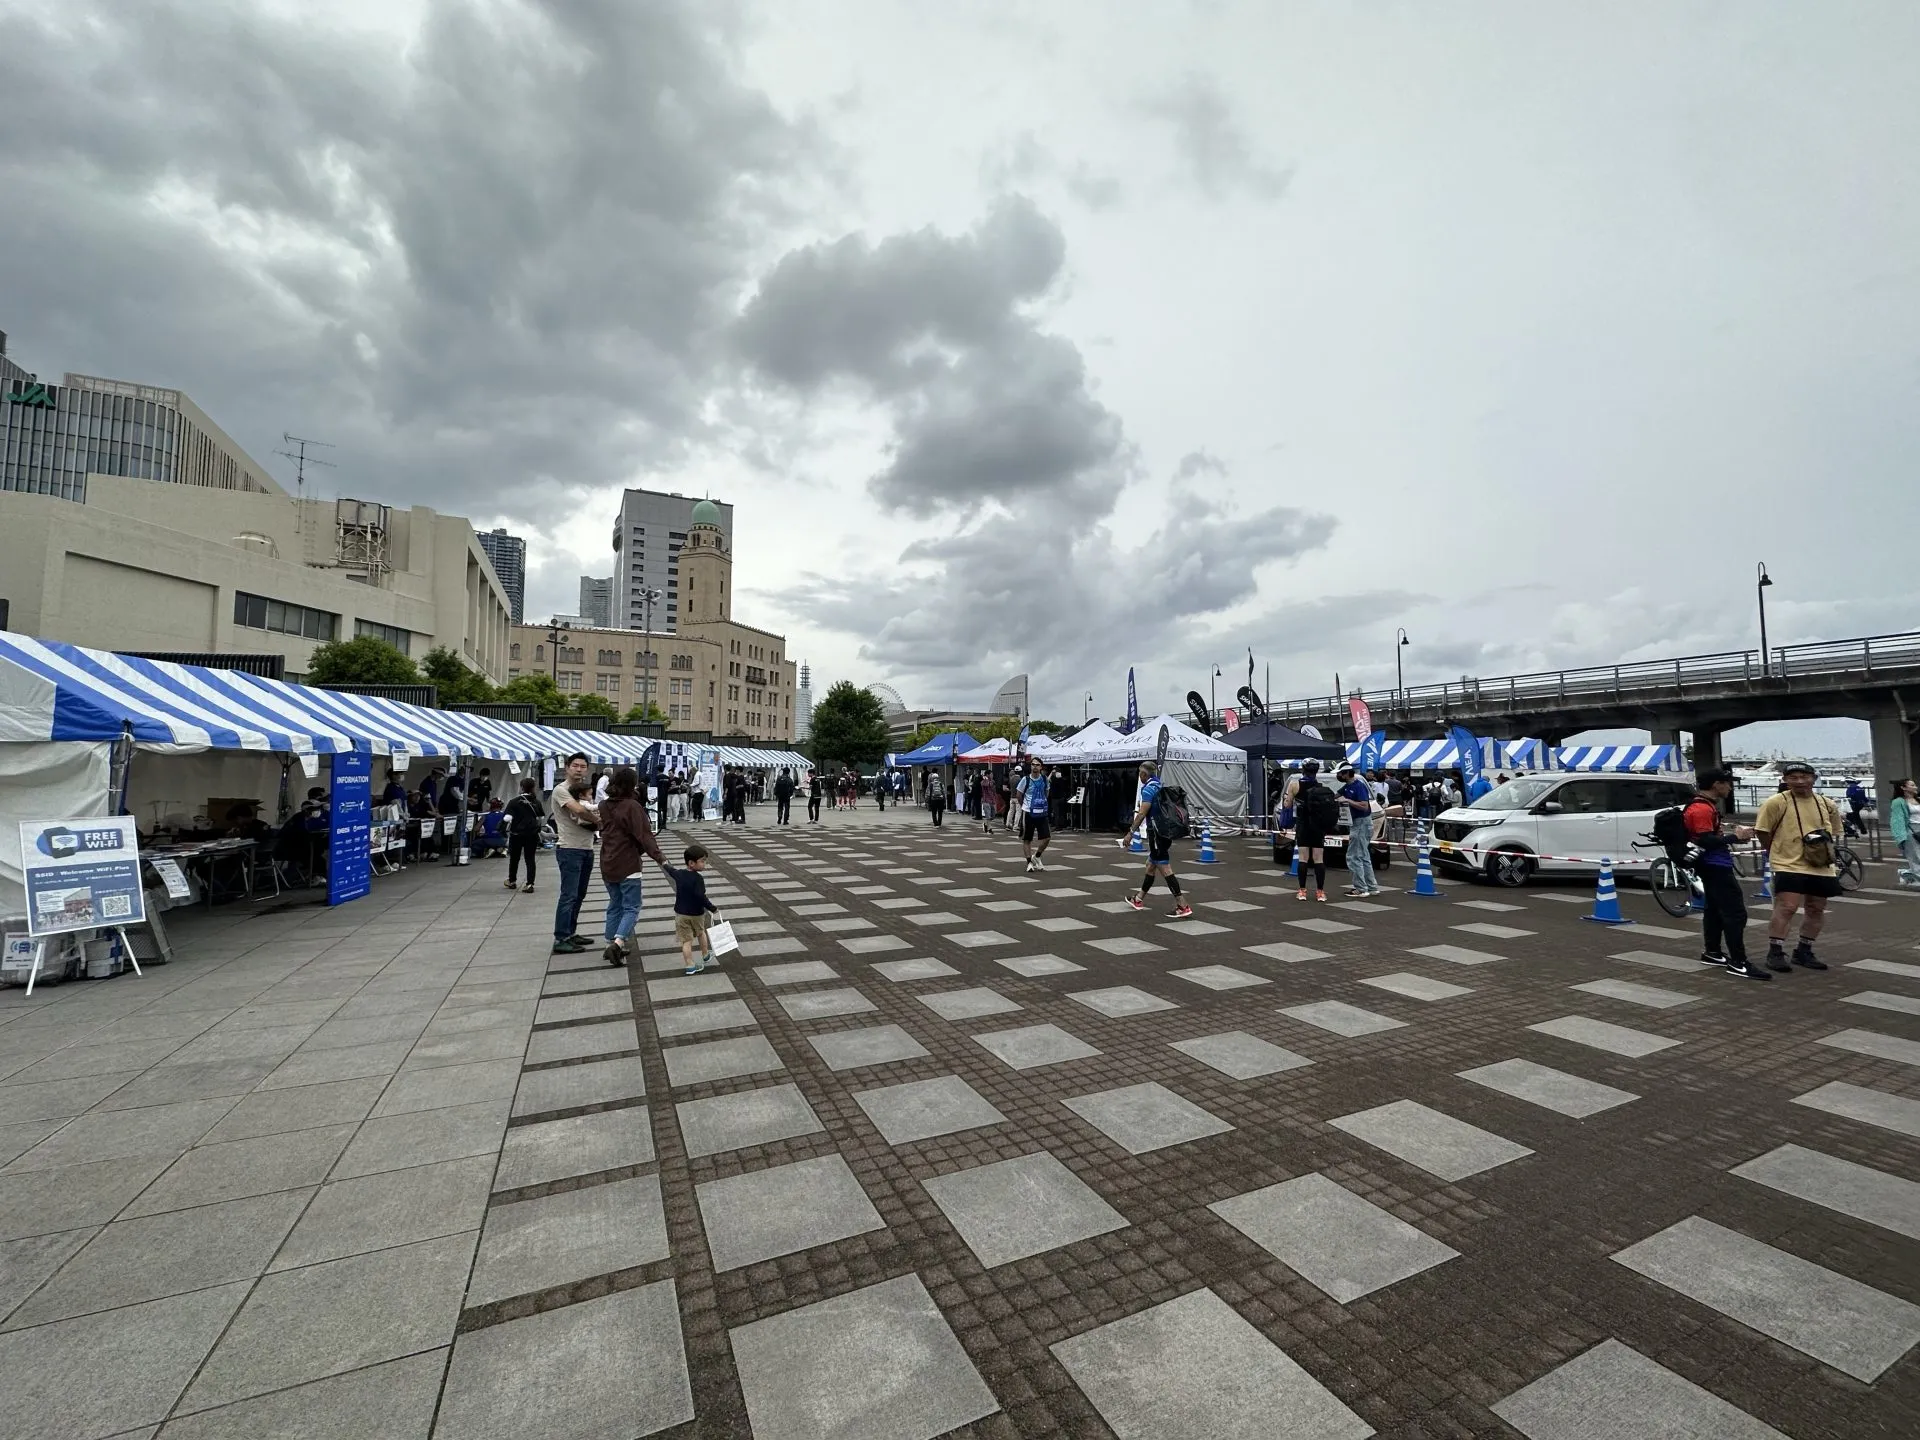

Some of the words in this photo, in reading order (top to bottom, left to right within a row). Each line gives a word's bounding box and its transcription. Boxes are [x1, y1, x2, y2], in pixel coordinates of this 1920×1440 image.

[1189, 699, 1206, 719] SMITH
[1365, 752, 1375, 769] VIE
[336, 776, 369, 784] INFORMATION
[84, 831, 117, 841] FREE
[85, 840, 118, 849] WI-FI
